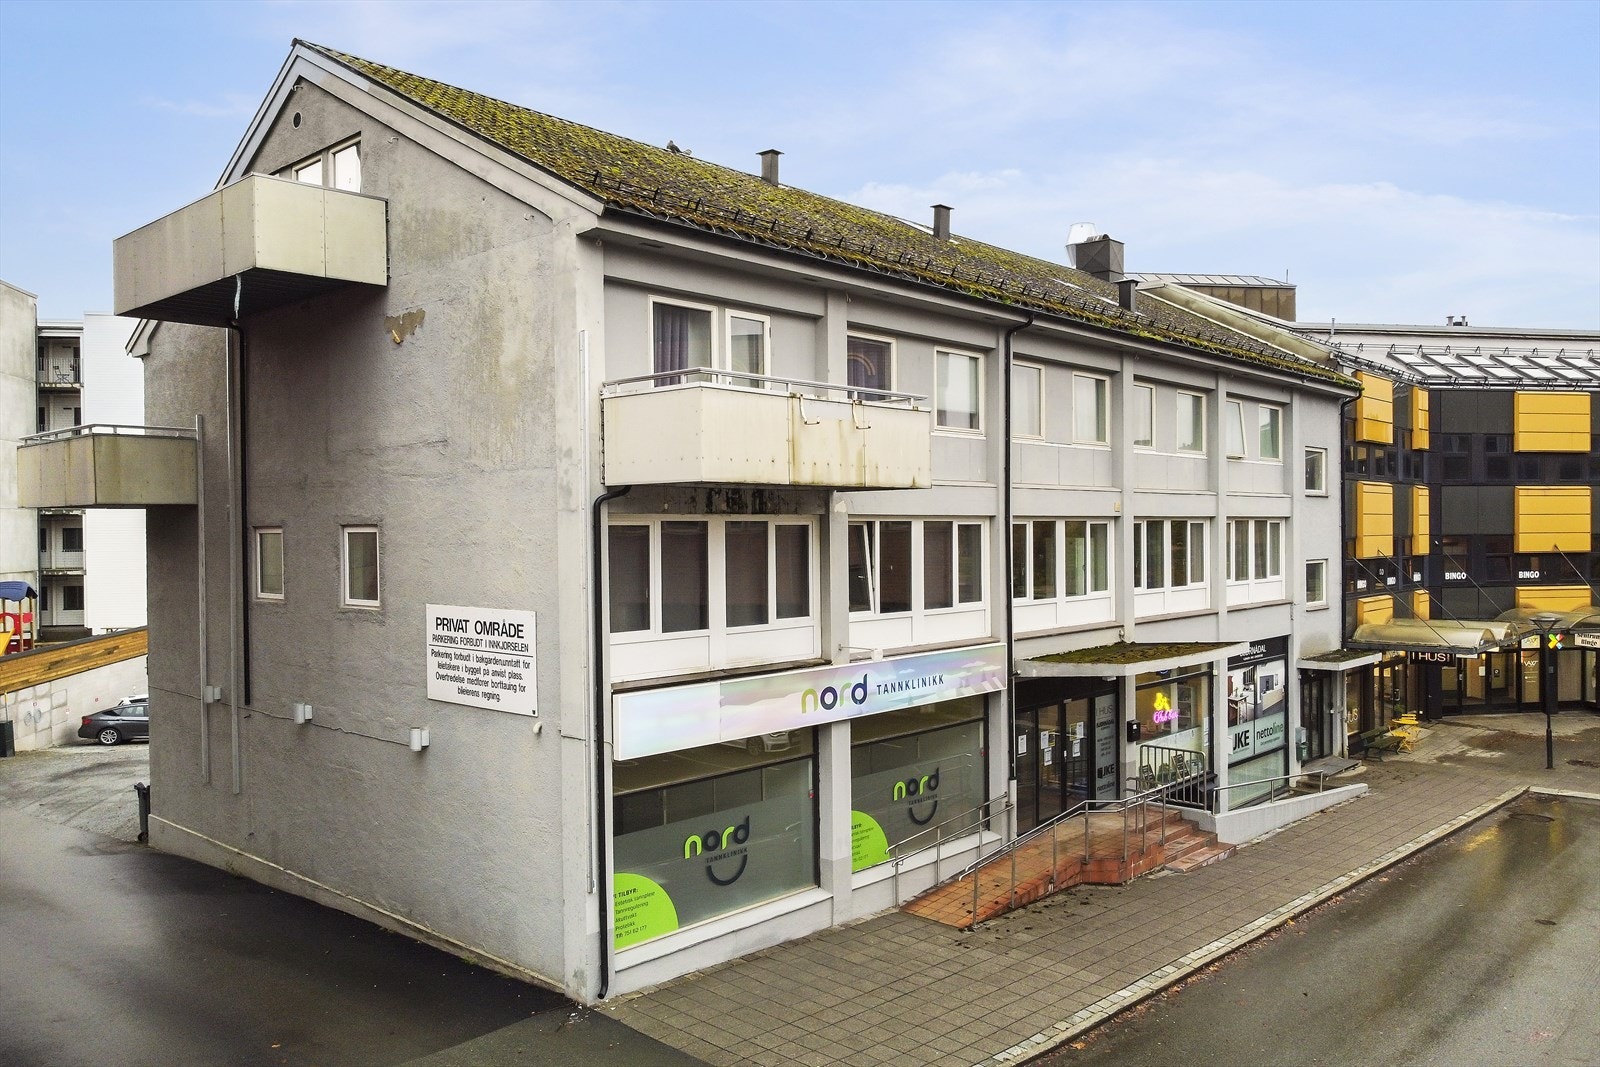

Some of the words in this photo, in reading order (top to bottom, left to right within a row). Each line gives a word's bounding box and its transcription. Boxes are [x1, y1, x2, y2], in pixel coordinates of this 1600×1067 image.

[1444, 572, 1467, 580] BINGO
[1518, 571, 1540, 579] BINGO
[435, 617, 470, 634] PRIVAT
[474, 619, 525, 639] OMRÅDE
[432, 634, 459, 645] PARKERING
[460, 637, 483, 648] FORBUDT
[431, 648, 452, 661] Parkering
[454, 652, 471, 661] forbudt
[523, 660, 531, 669] for
[1418, 652, 1446, 662] HUS
[437, 661, 460, 671] leietakere
[465, 664, 481, 675] bygget
[491, 669, 506, 678] anvist
[436, 671, 465, 683] Overtredelse
[491, 679, 518, 693] borttauing
[518, 683, 527, 692] for
[801, 673, 868, 714] nord
[876, 674, 944, 695] TANNKLINIKK
[1256, 722, 1284, 740] nettoline
[1232, 730, 1250, 751] JKE
[1103, 763, 1115, 777] JKE
[893, 767, 939, 801] nord
[685, 815, 749, 860] nord
[706, 848, 748, 863] TANNKLINIKK
